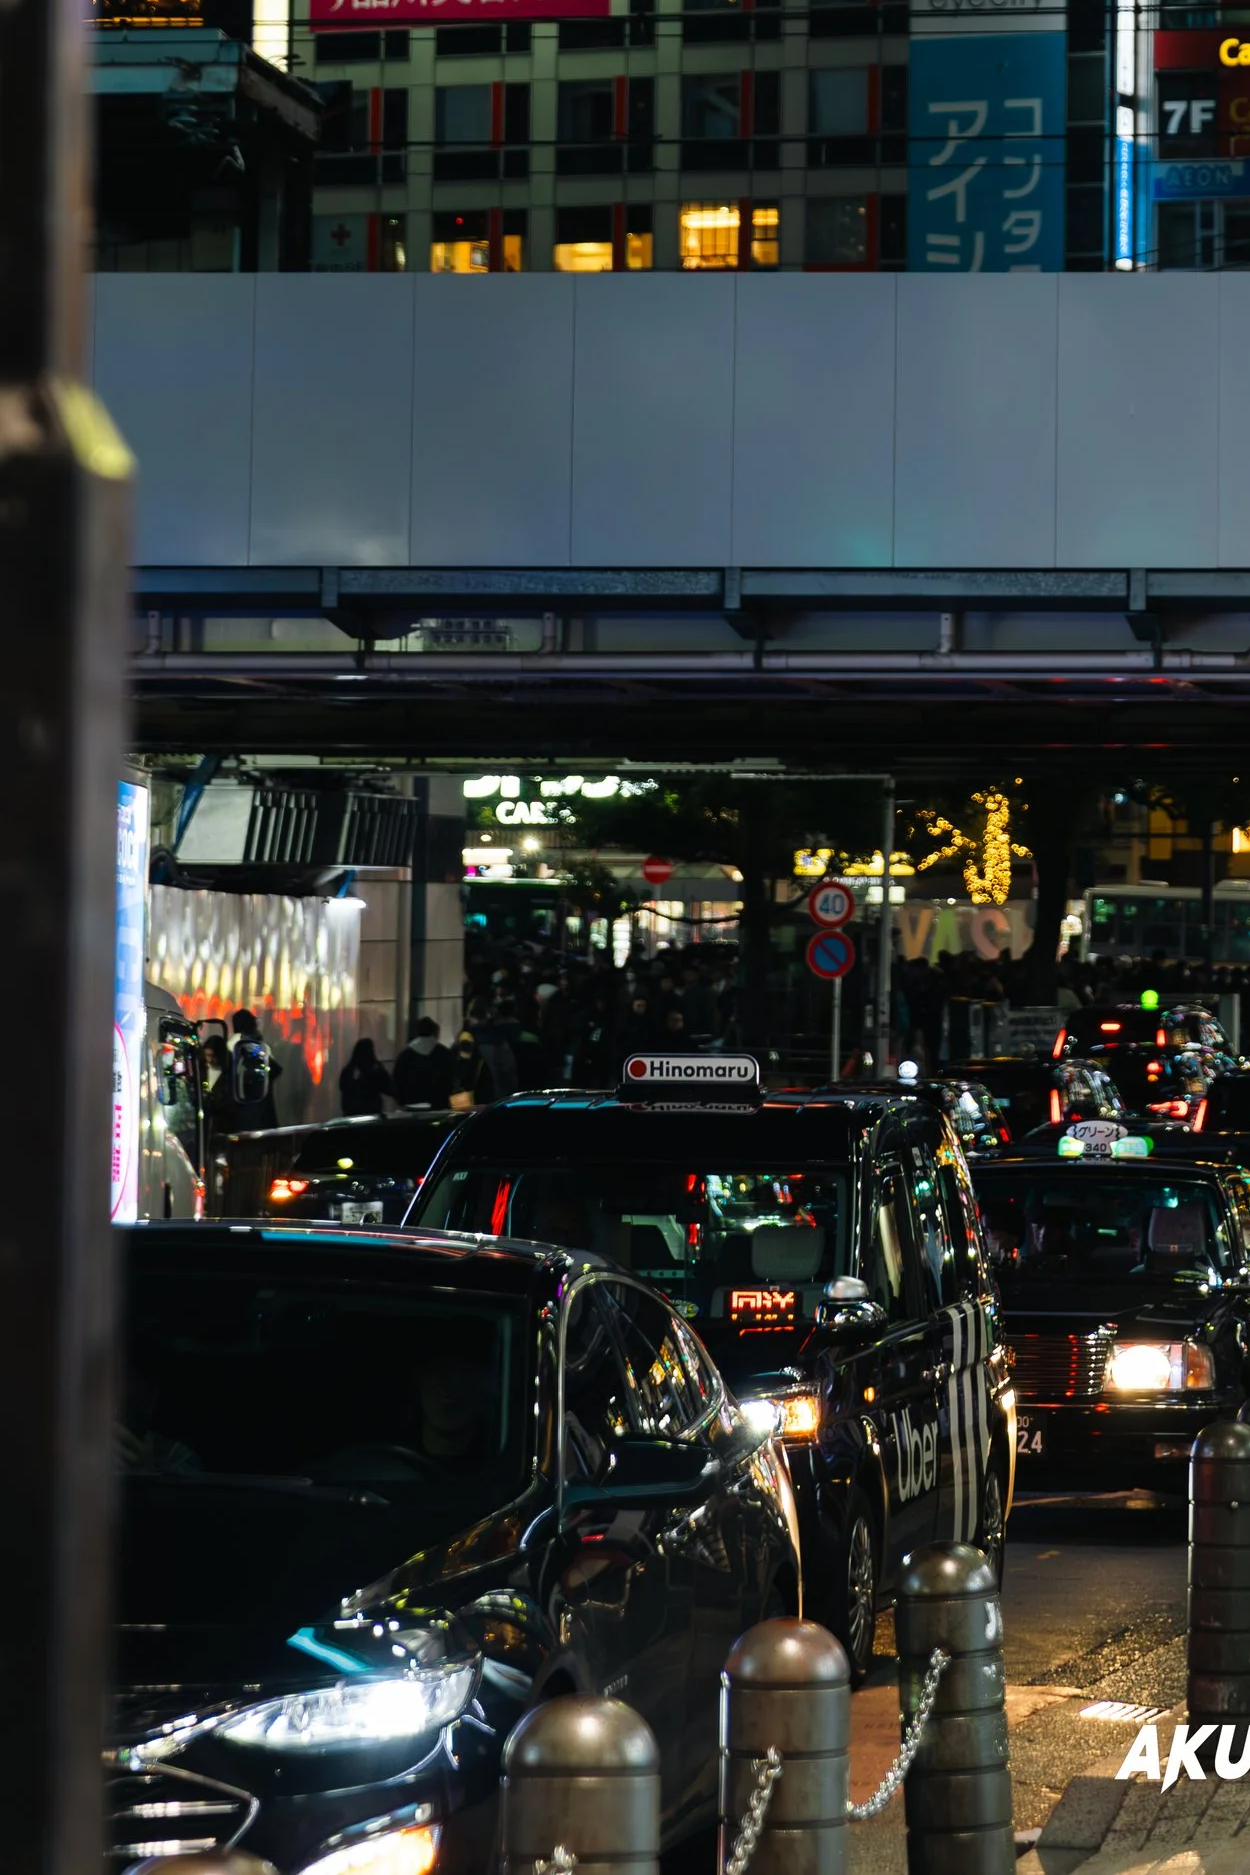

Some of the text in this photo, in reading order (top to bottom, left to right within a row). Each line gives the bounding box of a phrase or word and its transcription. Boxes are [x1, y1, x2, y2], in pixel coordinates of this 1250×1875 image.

[1163, 99, 1216, 135] 7F
[1003, 98, 1043, 272] コンタ
[819, 893, 846, 915] 40
[649, 1059, 750, 1080] Hinomaru
[1075, 1125, 1121, 1140] グリーン
[1085, 1143, 1107, 1153] 340
[889, 1403, 939, 1503] Uber
